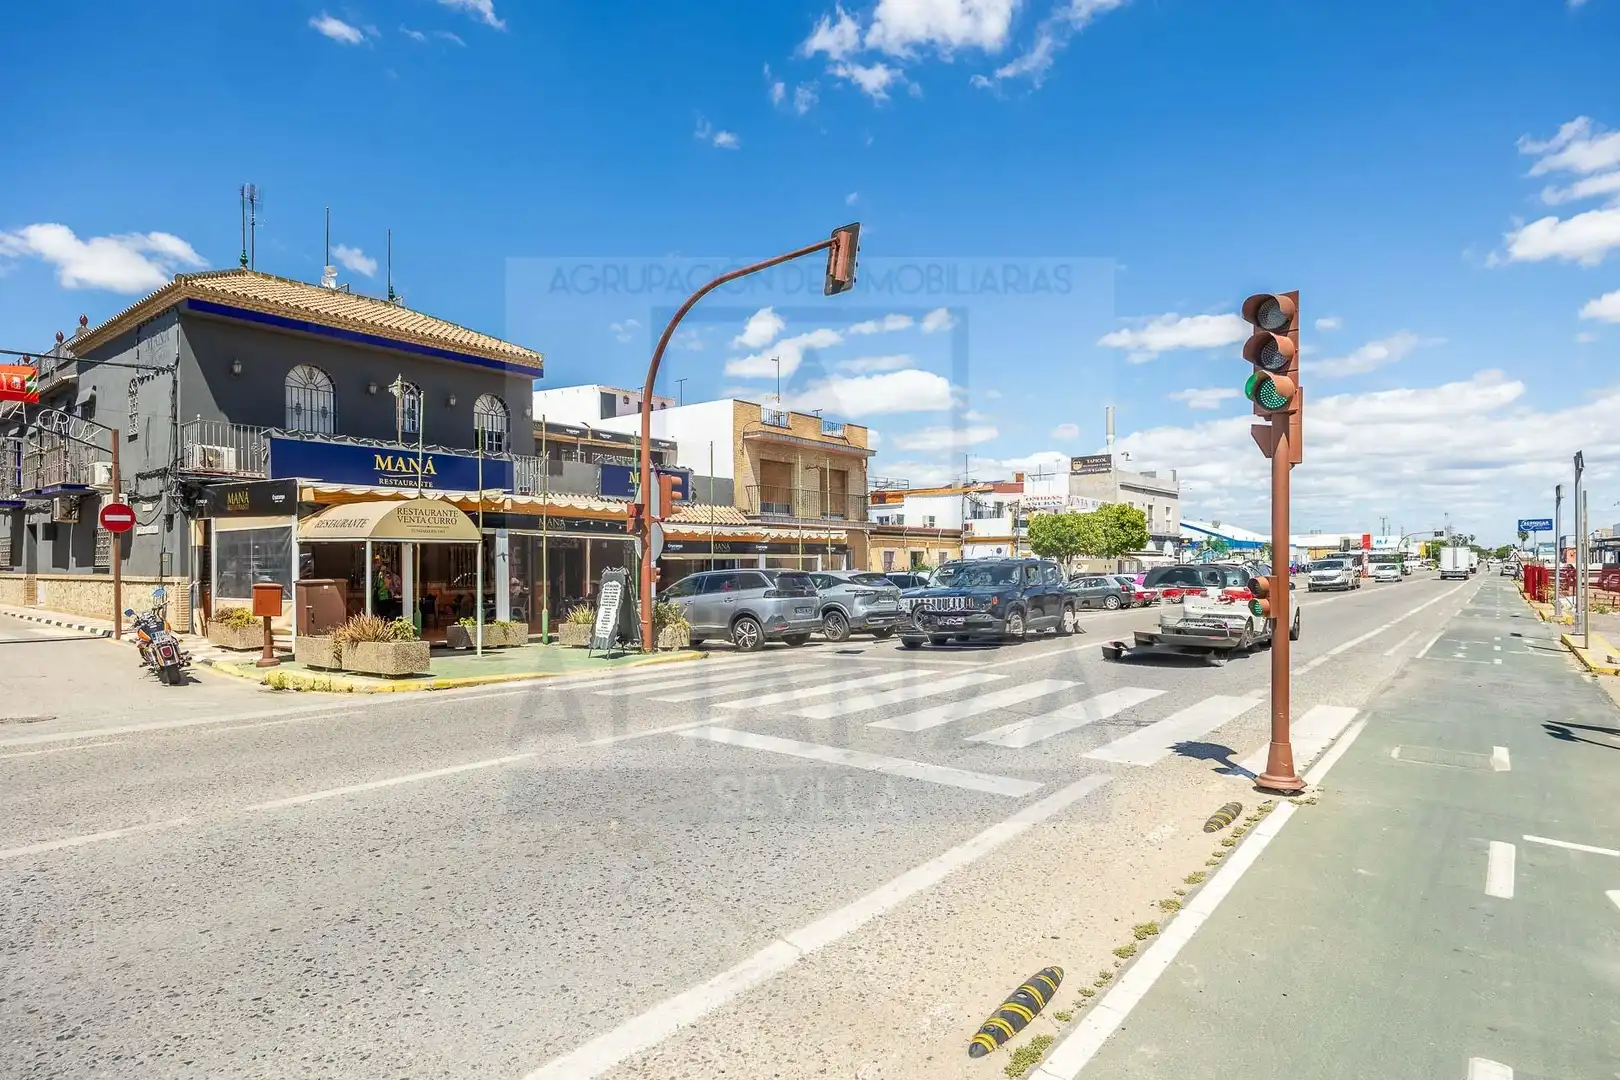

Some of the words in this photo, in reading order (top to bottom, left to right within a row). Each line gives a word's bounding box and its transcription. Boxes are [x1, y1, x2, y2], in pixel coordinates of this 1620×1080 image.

[373, 454, 438, 475] MANÁ
[378, 477, 434, 488] RESTAURANTE
[397, 507, 459, 518] RESTAURANTE
[314, 518, 370, 529] RESTAURANTE
[397, 515, 427, 524] VENTA
[427, 516, 458, 525] CURRO
